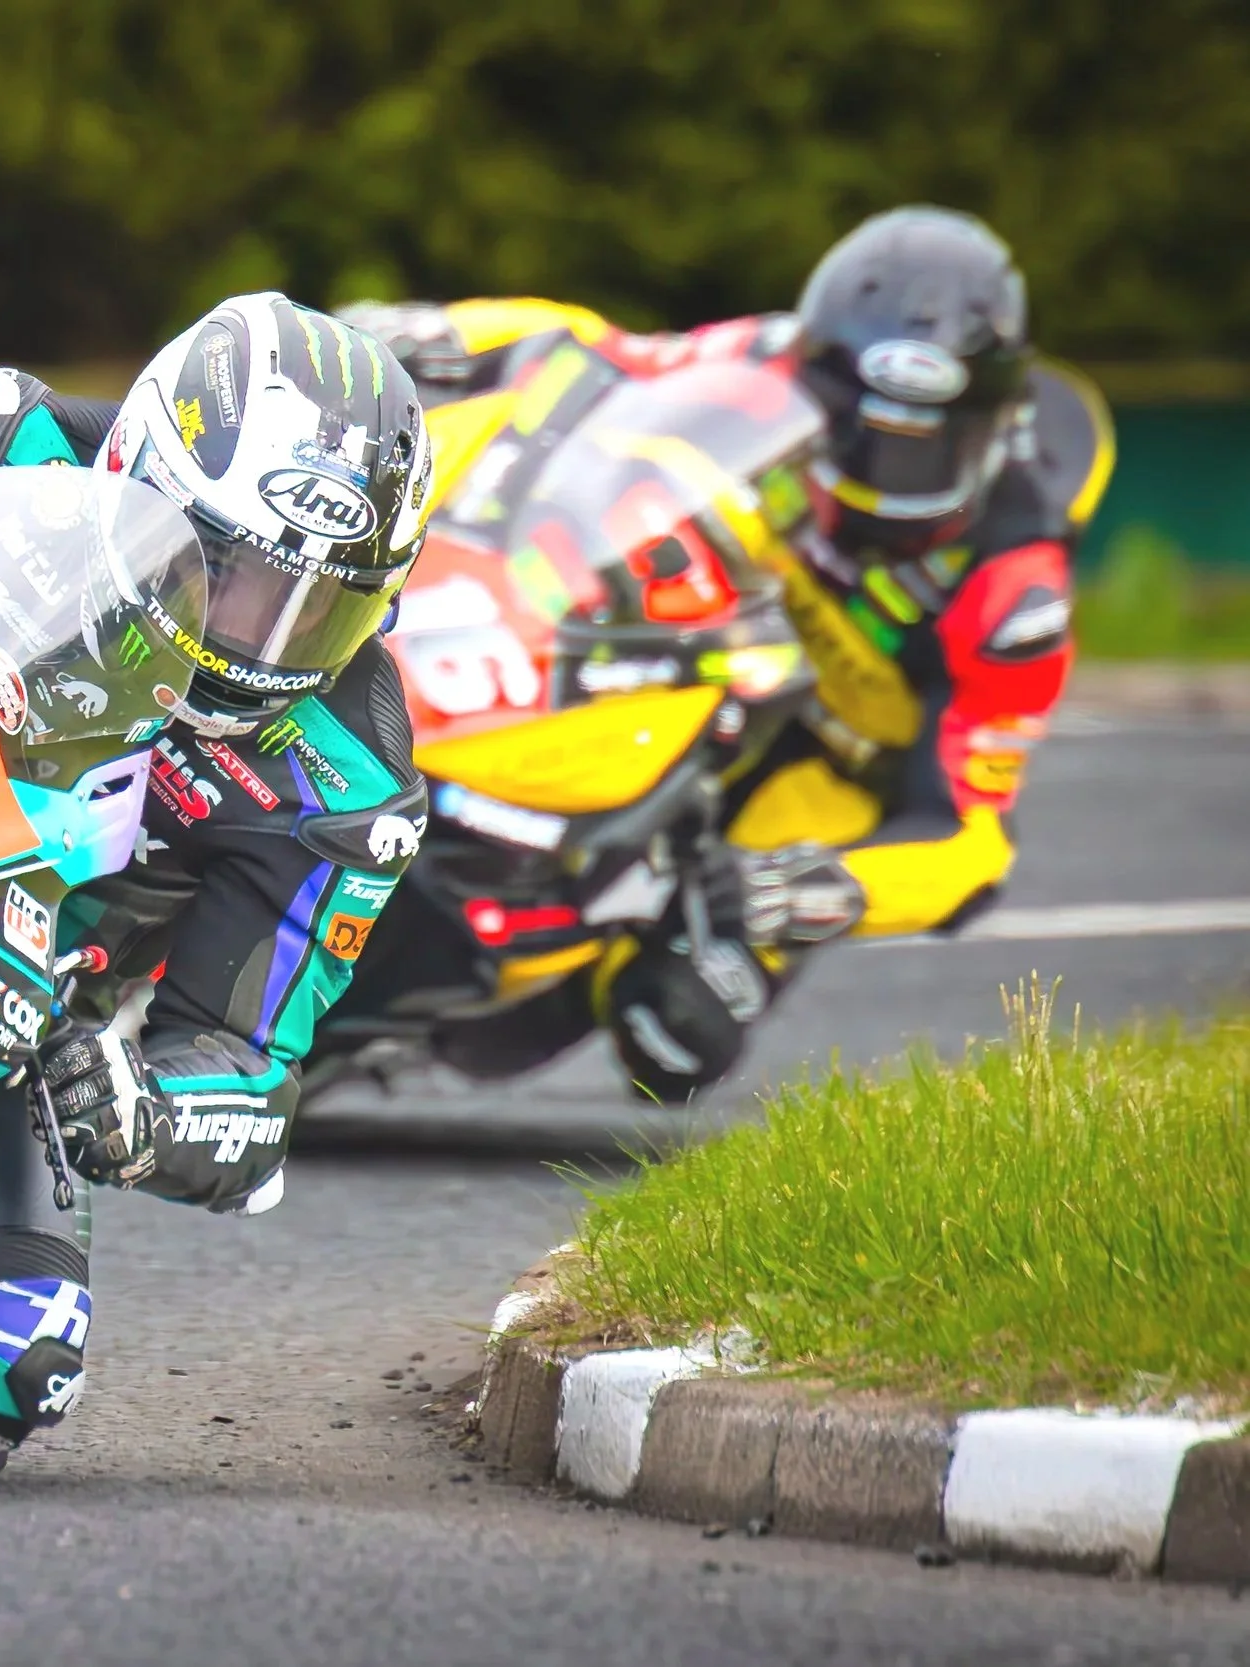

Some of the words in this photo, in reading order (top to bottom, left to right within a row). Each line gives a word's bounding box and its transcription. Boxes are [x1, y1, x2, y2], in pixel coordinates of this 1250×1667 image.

[216, 353, 238, 423] PROSPERITY
[263, 476, 366, 530] Arai
[233, 525, 358, 582] PARAMOUNT
[264, 556, 320, 583] FLOORS
[147, 597, 323, 691] THEVISORSHOP.COM
[296, 736, 350, 795] MONSTER
